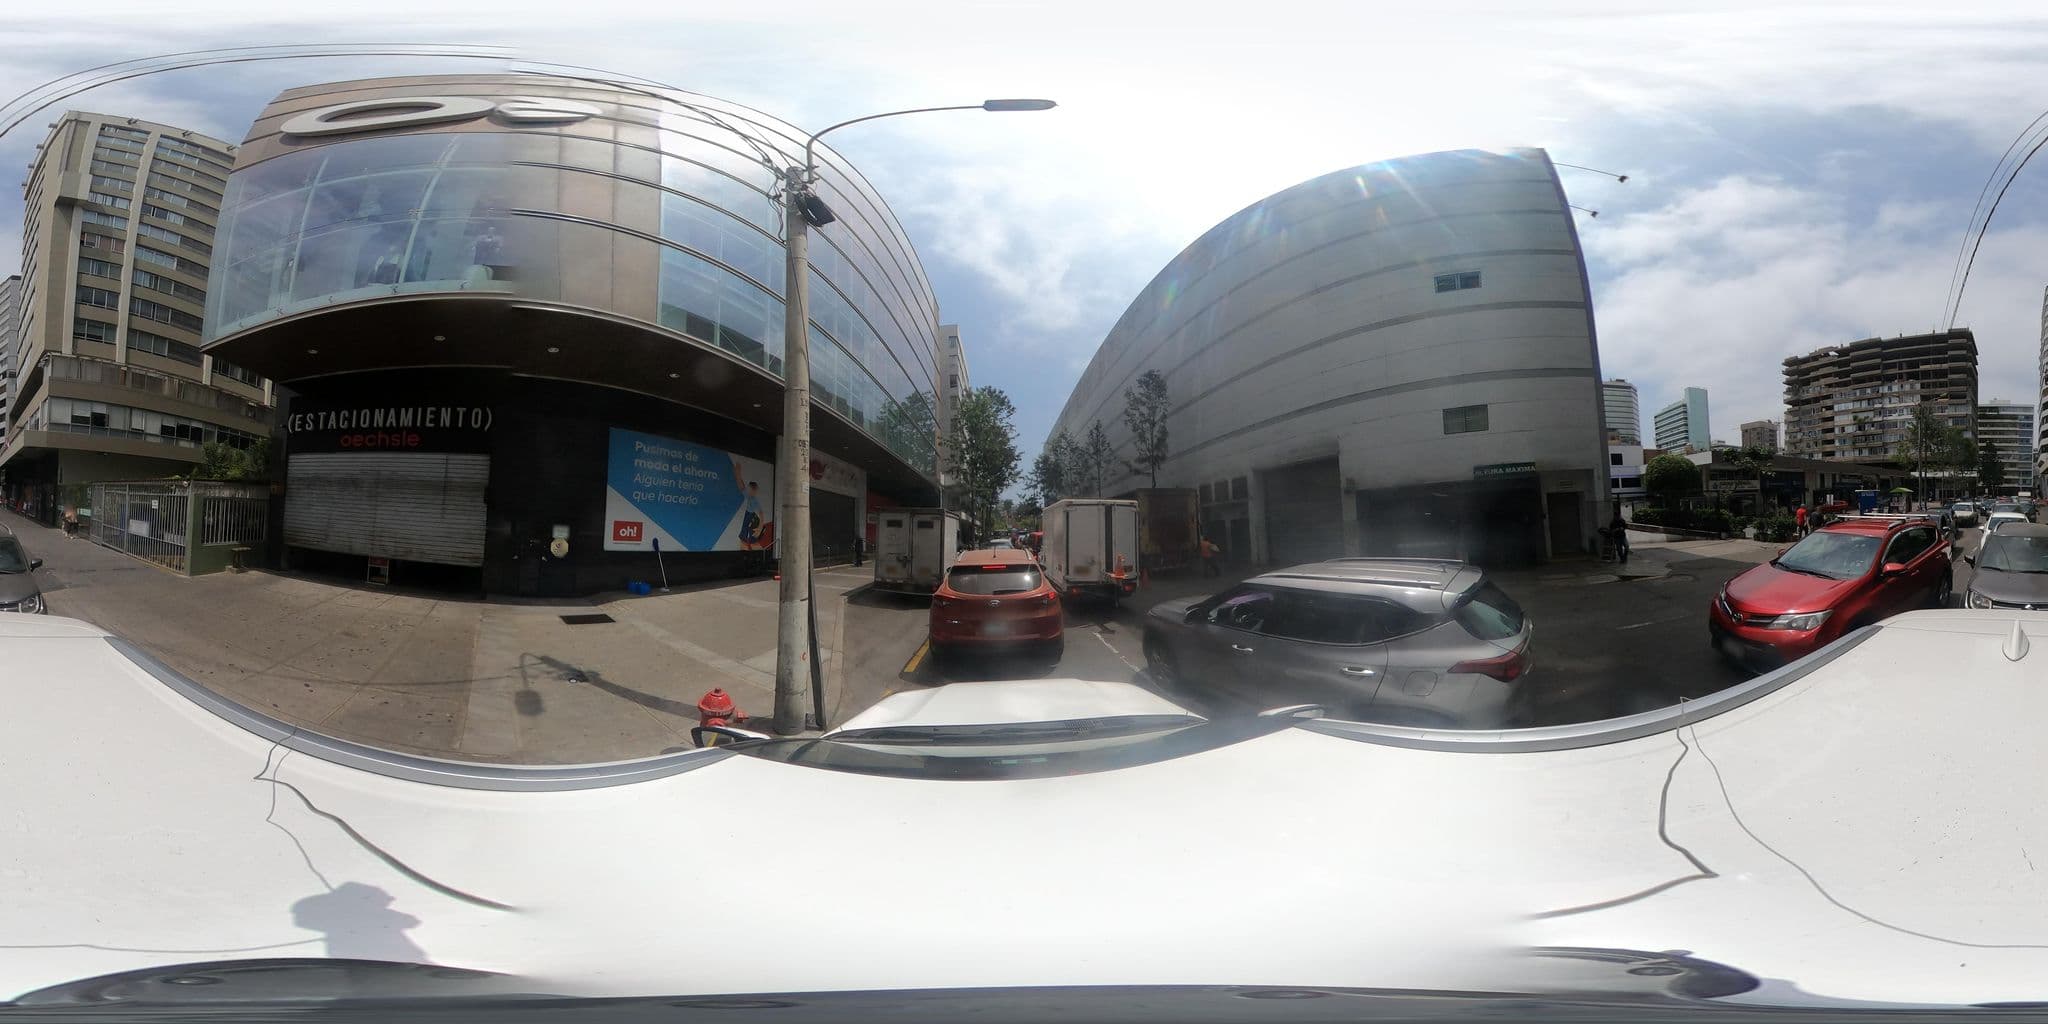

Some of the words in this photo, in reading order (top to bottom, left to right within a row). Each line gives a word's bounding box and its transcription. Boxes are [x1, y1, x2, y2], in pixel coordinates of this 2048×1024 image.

[288, 407, 493, 433] (ESTACIONAMIENTO)
[340, 431, 421, 447] oechsle
[685, 450, 698, 462] de
[634, 457, 669, 472] moda
[672, 463, 682, 473] el
[634, 473, 675, 488] Alguien
[633, 490, 655, 503] que
[620, 526, 637, 537] oh!
